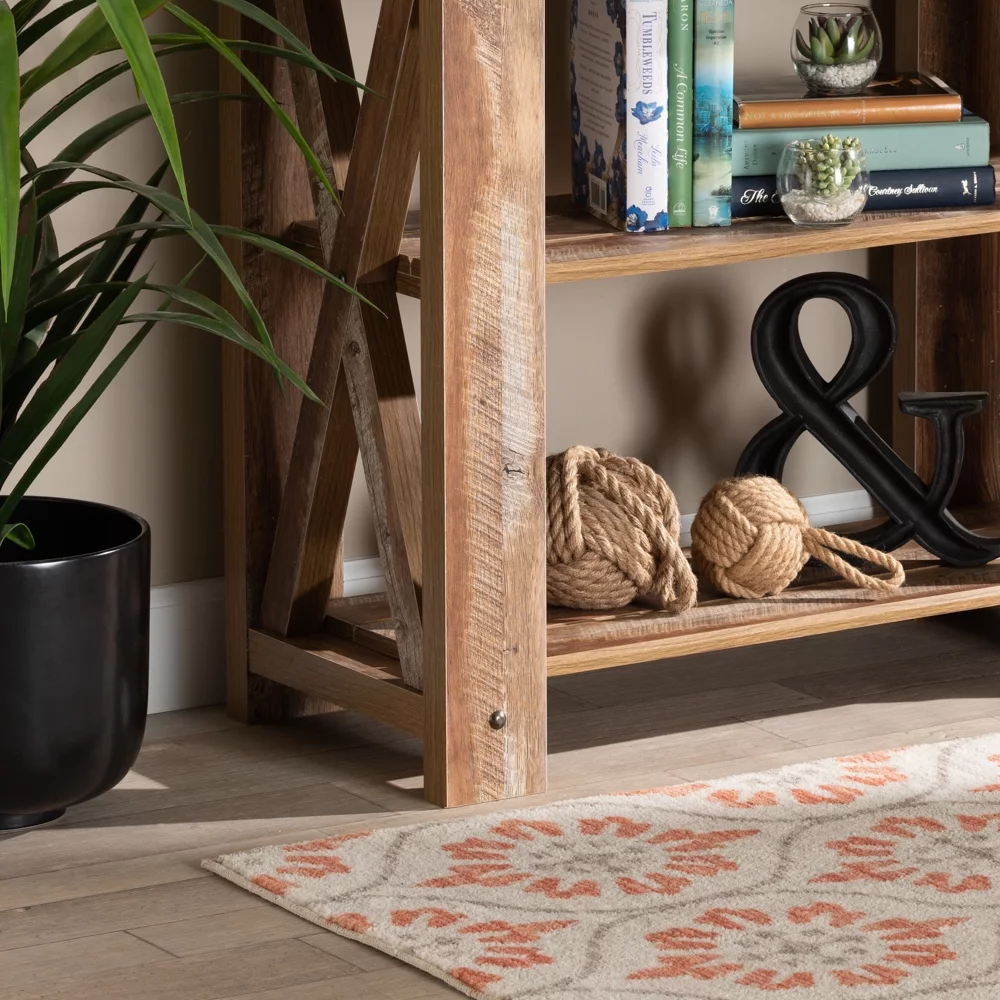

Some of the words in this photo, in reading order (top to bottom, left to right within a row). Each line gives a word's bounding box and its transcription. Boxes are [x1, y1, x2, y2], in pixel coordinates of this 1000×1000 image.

[642, 11, 657, 95] TUMBLEWEEDS
[676, 82, 688, 142] Common
[633, 131, 649, 175] Meacham
[672, 148, 688, 170] Life
[740, 188, 769, 205] The
[868, 186, 904, 198] Courtney
[904, 183, 939, 196] Sullivan
